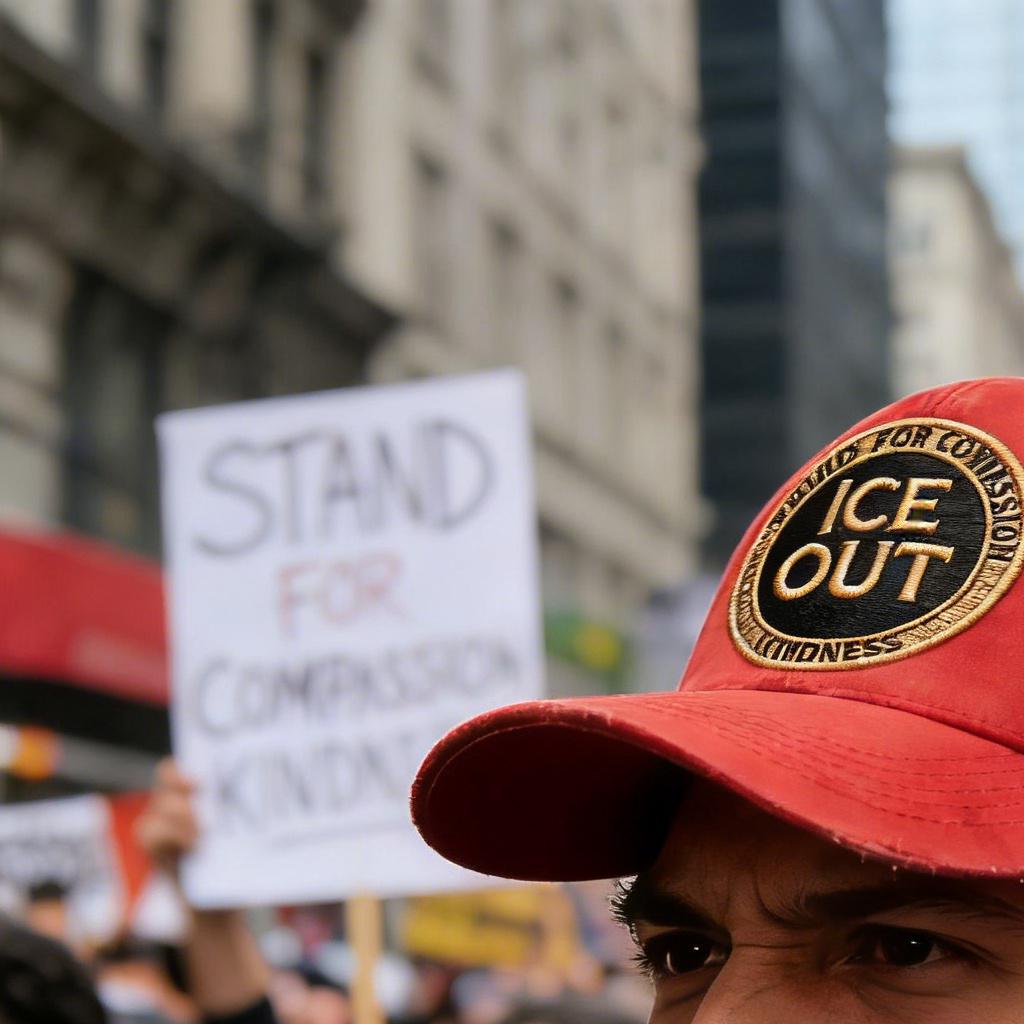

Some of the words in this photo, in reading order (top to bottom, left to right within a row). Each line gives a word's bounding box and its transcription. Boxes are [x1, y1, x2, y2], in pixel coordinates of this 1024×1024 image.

[871, 426, 932, 453] FOR
[193, 419, 494, 557] STAND
[817, 477, 953, 535] ICE
[278, 554, 407, 640] FOR
[773, 540, 955, 602] OUT
